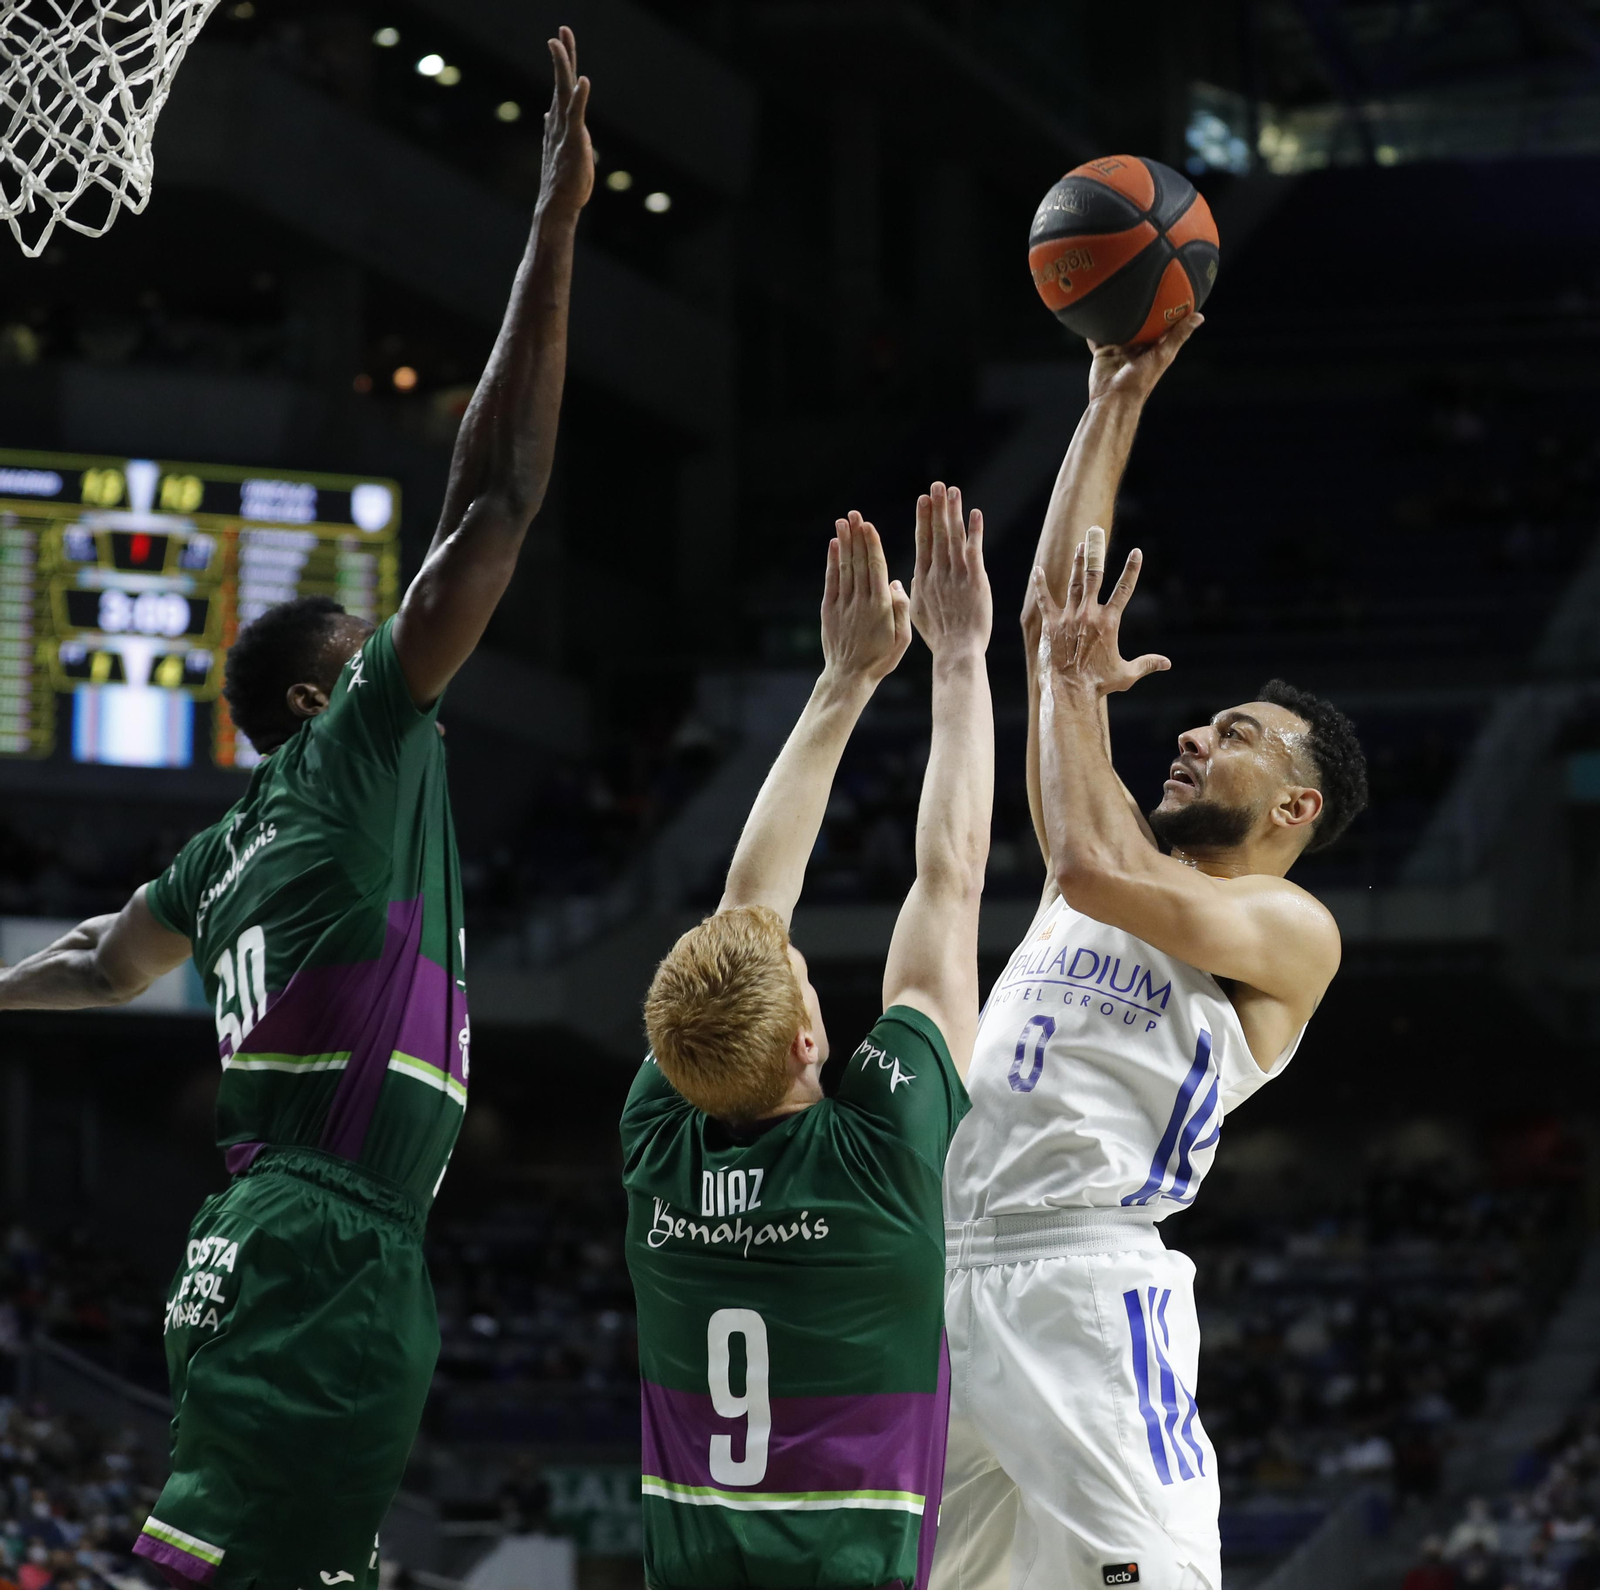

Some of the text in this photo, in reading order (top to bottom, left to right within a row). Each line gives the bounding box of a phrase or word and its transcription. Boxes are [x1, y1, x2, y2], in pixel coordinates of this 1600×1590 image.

[1005, 945, 1172, 1010] PALLADIUM
[993, 987, 1157, 1033] HOTEL GROUP
[1007, 1014, 1057, 1093] 0
[701, 1165, 764, 1217] DÍAZ
[192, 1271, 226, 1304] SOL
[707, 1308, 771, 1487] 9
[1106, 1571, 1132, 1584] acb
